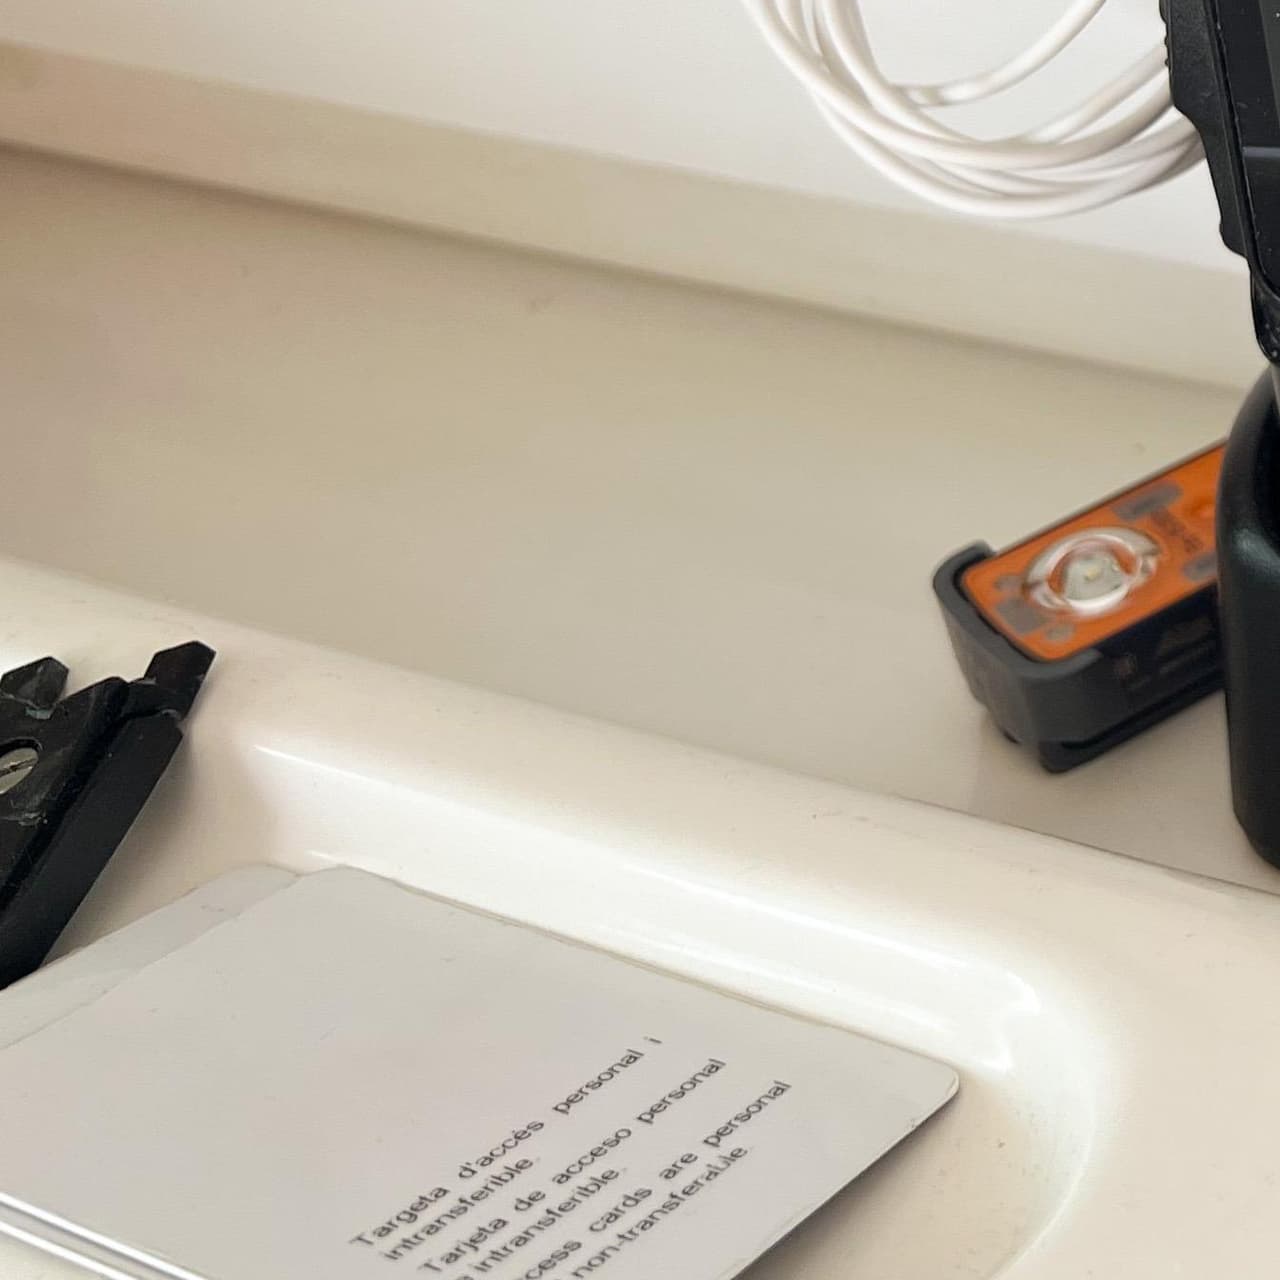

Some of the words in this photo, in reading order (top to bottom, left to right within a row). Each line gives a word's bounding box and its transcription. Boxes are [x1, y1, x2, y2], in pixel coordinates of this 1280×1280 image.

[349, 1186, 451, 1249] Targeta
[552, 1048, 645, 1116] personal
[419, 1217, 509, 1274] Tarjeta
[514, 1190, 548, 1213] de
[552, 1127, 633, 1186] acceso
[636, 1057, 727, 1126] personal
[589, 1187, 653, 1235] cards
[660, 1151, 699, 1181] are
[702, 1080, 792, 1149] personal
